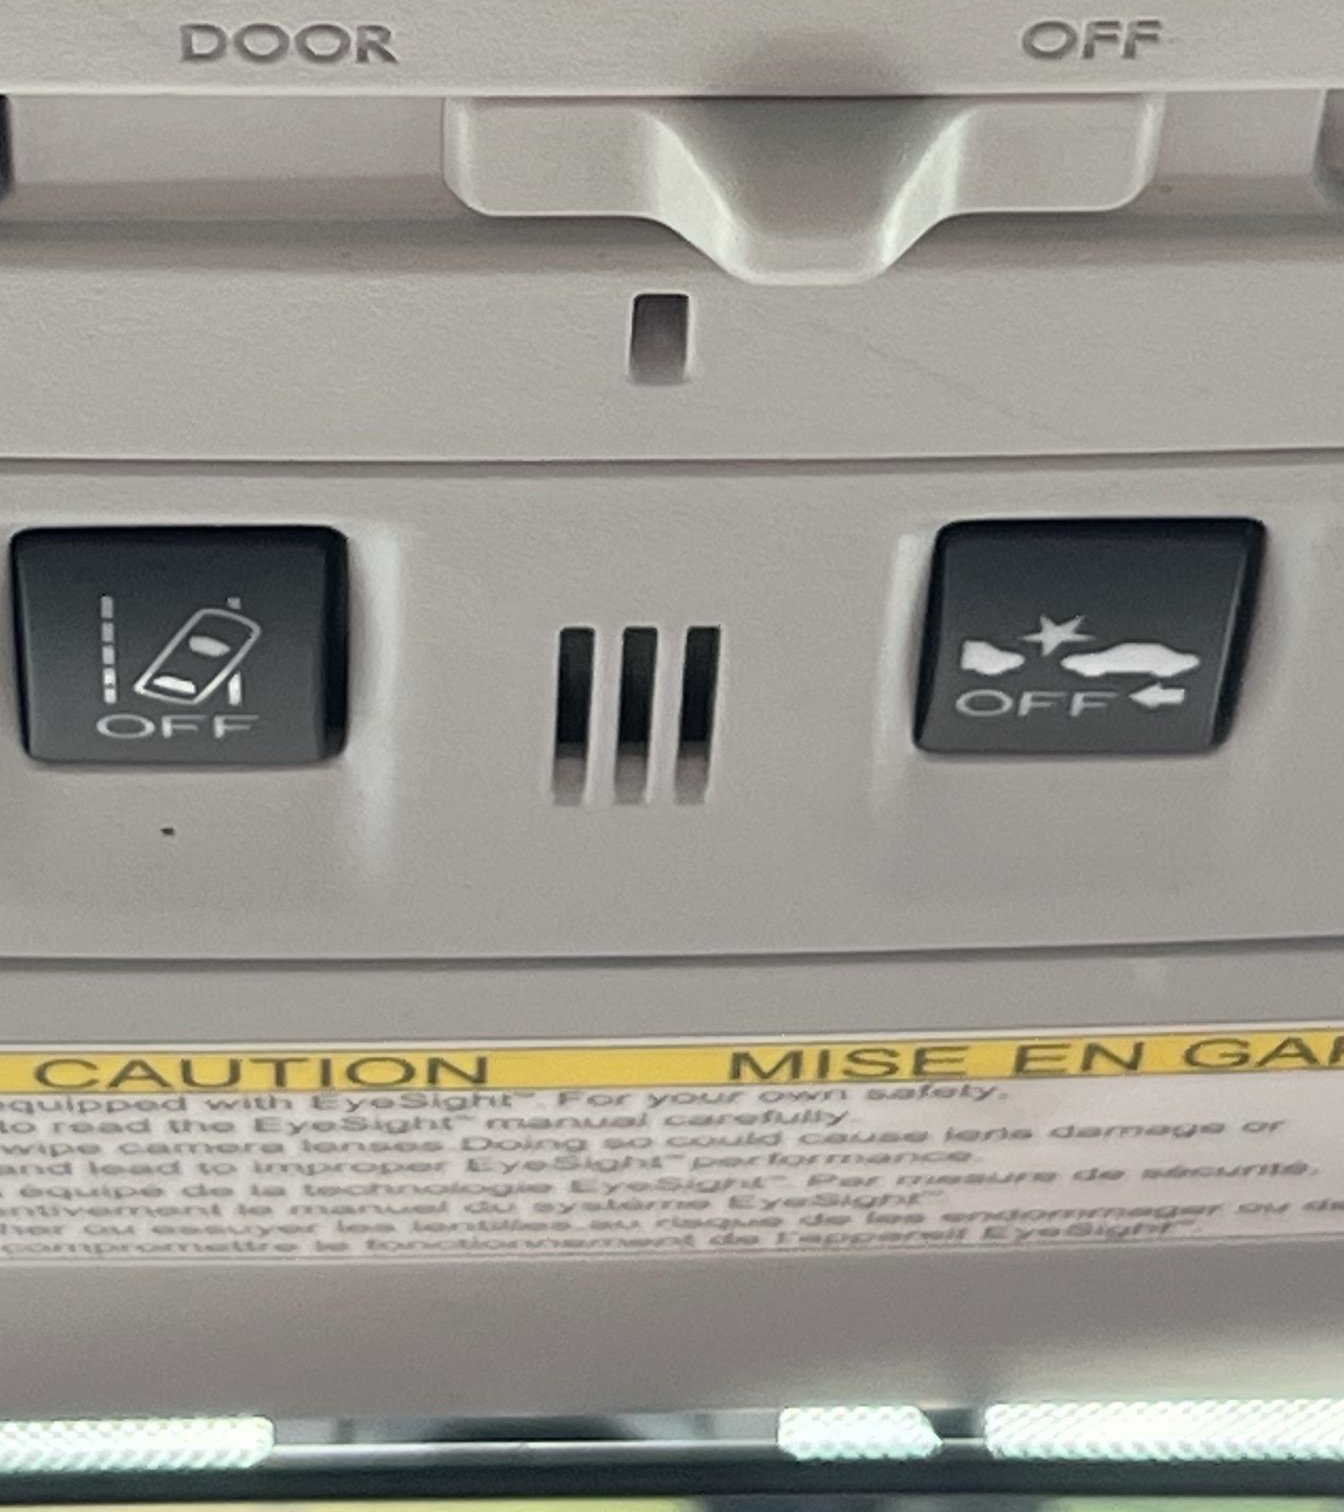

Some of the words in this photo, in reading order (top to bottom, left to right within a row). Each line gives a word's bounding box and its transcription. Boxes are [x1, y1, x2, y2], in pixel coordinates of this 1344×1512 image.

[179, 22, 400, 65] DOOR
[1021, 17, 1164, 62] OFF
[955, 688, 1118, 717] OFF
[96, 713, 260, 739] OFF
[34, 1057, 489, 1089] CAUTION
[728, 1046, 969, 1080] MISE
[1011, 1042, 1146, 1074] EN
[205, 1095, 294, 1112] with
[556, 1091, 632, 1107] For
[648, 1090, 743, 1109] your
[758, 1088, 847, 1104] own
[0, 1141, 102, 1158] wipe
[117, 1141, 285, 1156] camera
[460, 1136, 588, 1154] Doing
[602, 1137, 654, 1151] so
[666, 1130, 784, 1148] could
[798, 1131, 928, 1146] cause
[945, 1126, 1033, 1144] lens
[1049, 1122, 1226, 1141] damage
[1241, 1120, 1286, 1135] or
[52, 1118, 149, 1135] read
[167, 1118, 236, 1135] the
[486, 1112, 648, 1133] manual
[19, 1183, 165, 1201] équipé
[180, 1183, 236, 1199] de
[251, 1183, 286, 1198] la
[302, 1180, 553, 1198] technologie
[807, 1173, 880, 1188] Par
[896, 1171, 1058, 1186] mesure
[1073, 1167, 1125, 1182] de
[88, 1160, 181, 1177] lead
[197, 1161, 238, 1177] to
[253, 1159, 450, 1177] improper
